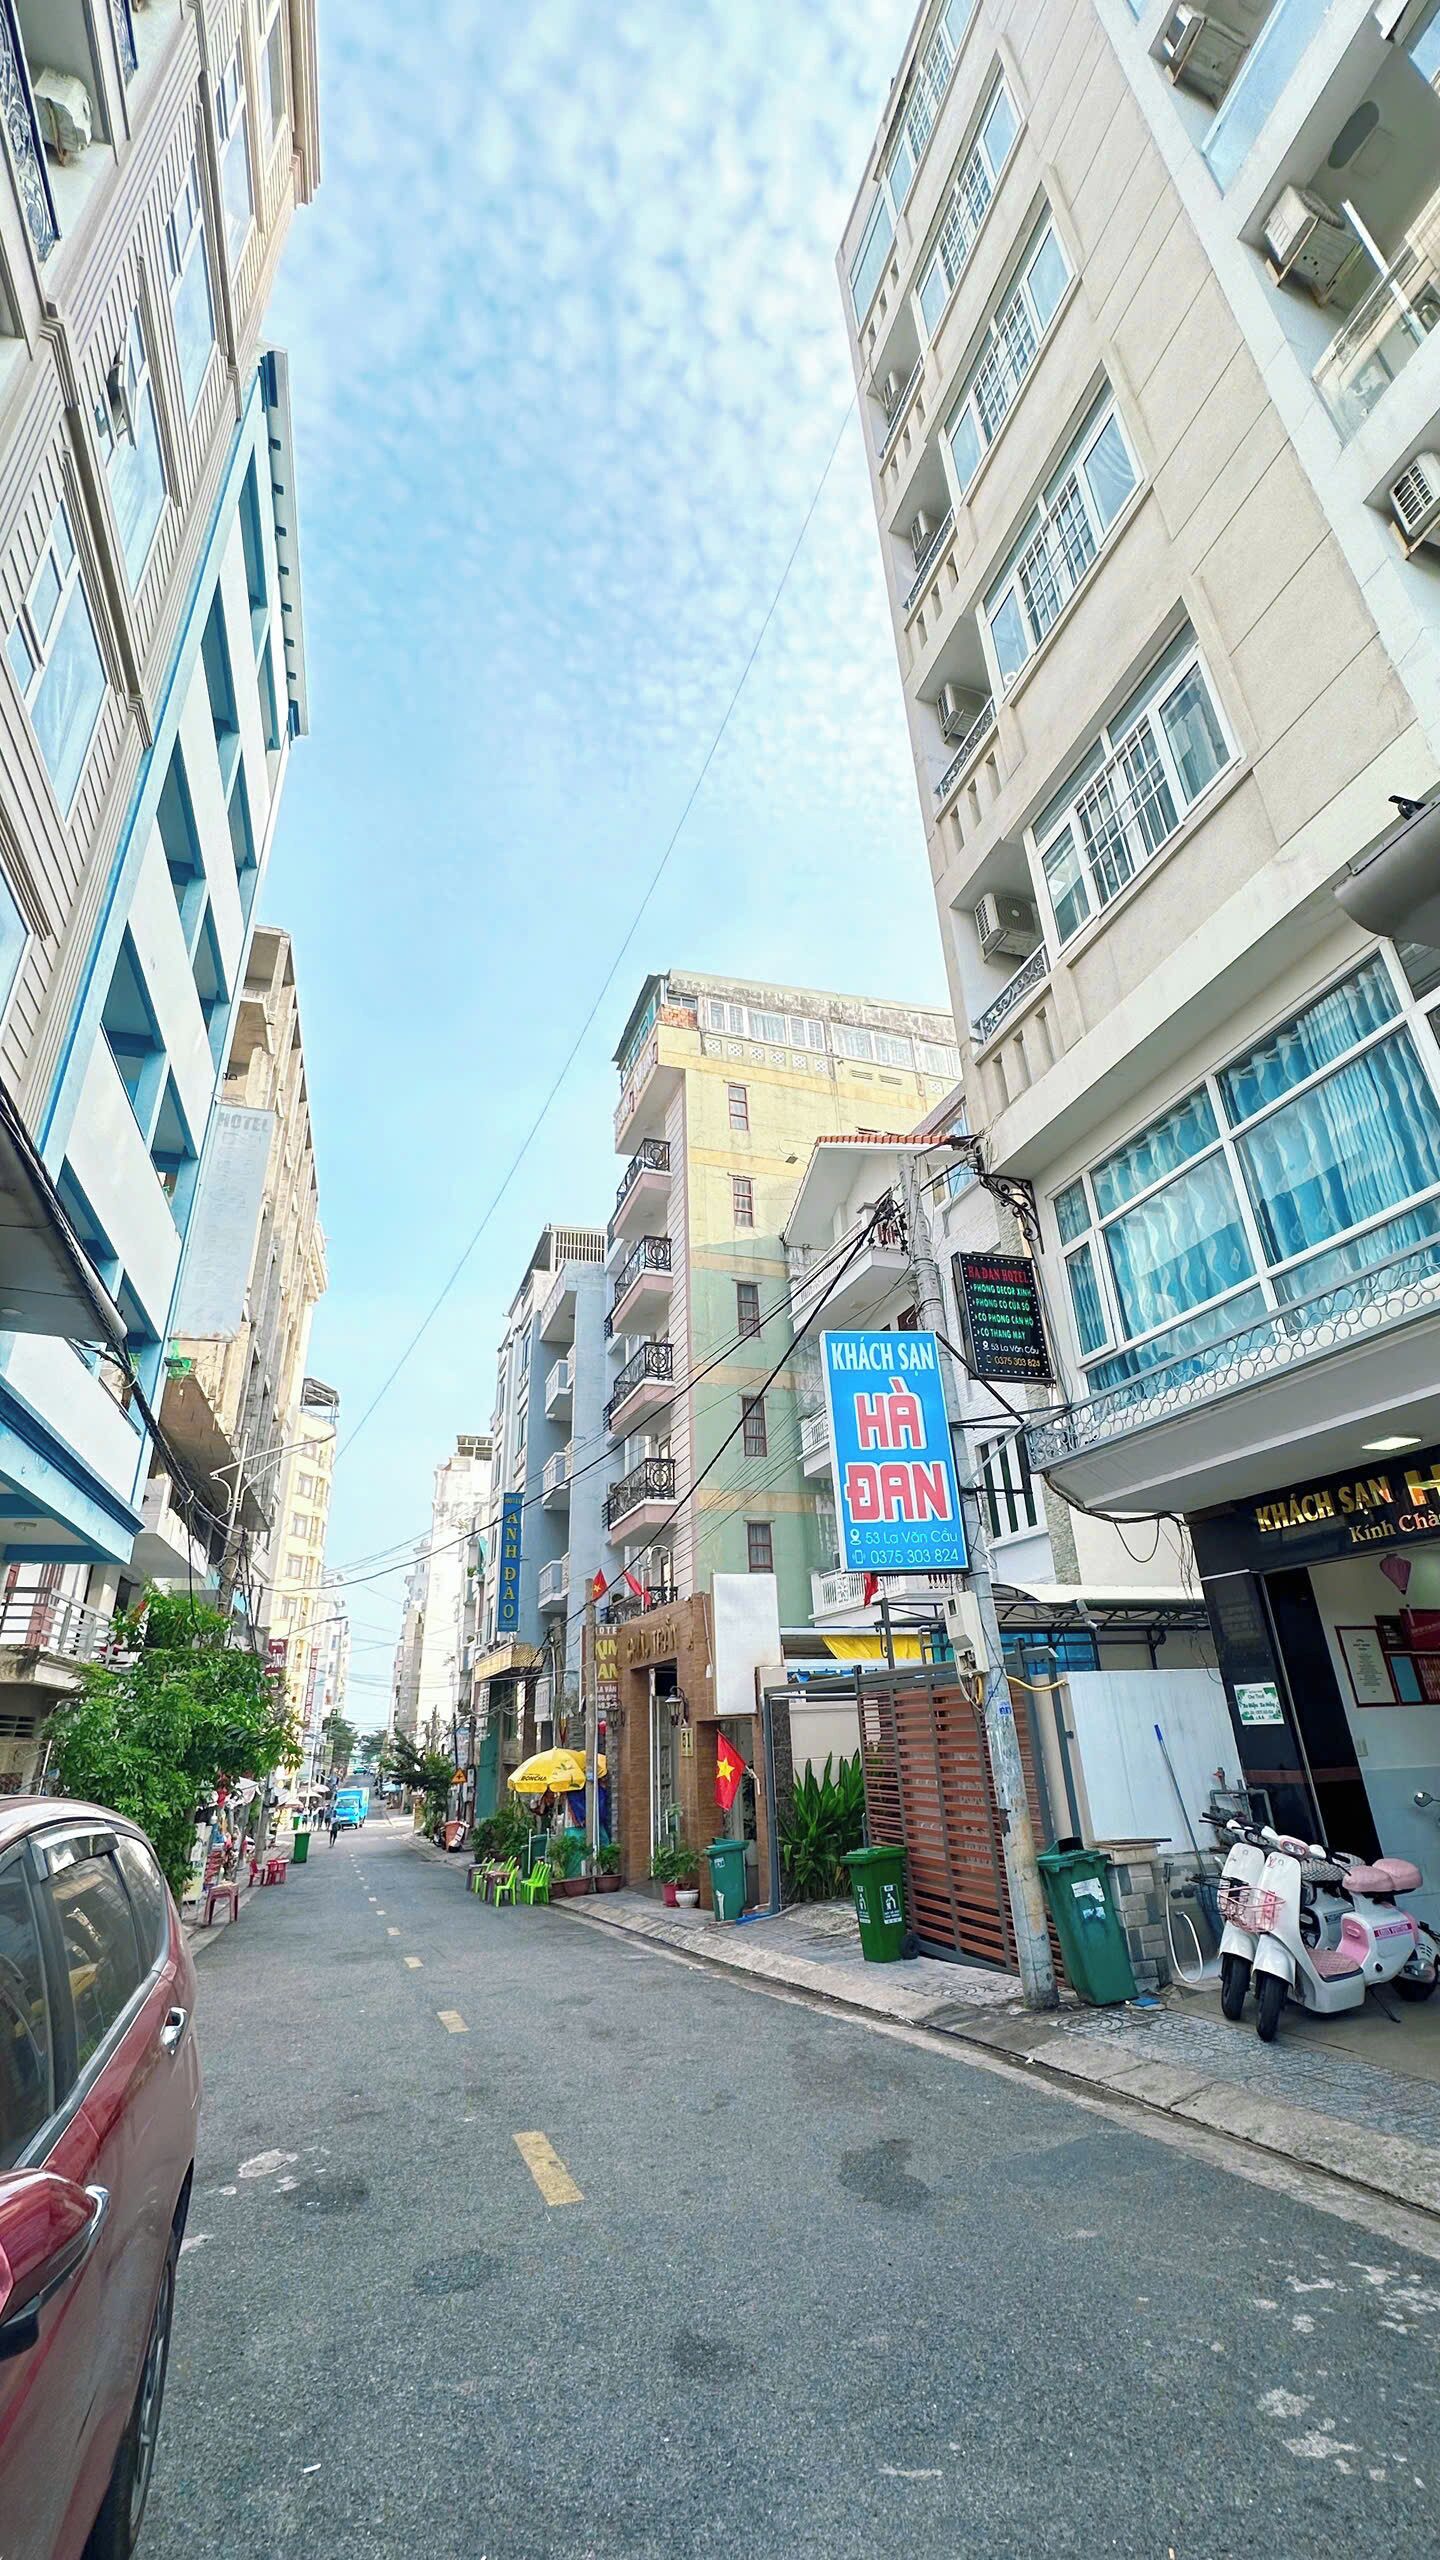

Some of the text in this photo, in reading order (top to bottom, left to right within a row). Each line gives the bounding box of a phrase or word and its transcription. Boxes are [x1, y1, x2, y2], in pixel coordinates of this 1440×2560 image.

[831, 1336, 935, 1376] KHÁCH SẠN
[990, 1342, 1000, 1351] 53
[994, 1355, 1013, 1366] 0375
[1013, 1356, 1027, 1367] 303
[854, 1376, 927, 1450] HÀ
[844, 1460, 953, 1523] ĐAN
[1255, 1491, 1336, 1532] KHÁCH
[1338, 1475, 1395, 1515] SẠN
[505, 1512, 519, 1559] ANH
[865, 1527, 958, 1544] 53 La Văn Cầu
[1349, 1510, 1440, 1543] Kính Chà
[870, 1547, 959, 1564] 0375 303 824
[682, 1732, 691, 1748] 51
